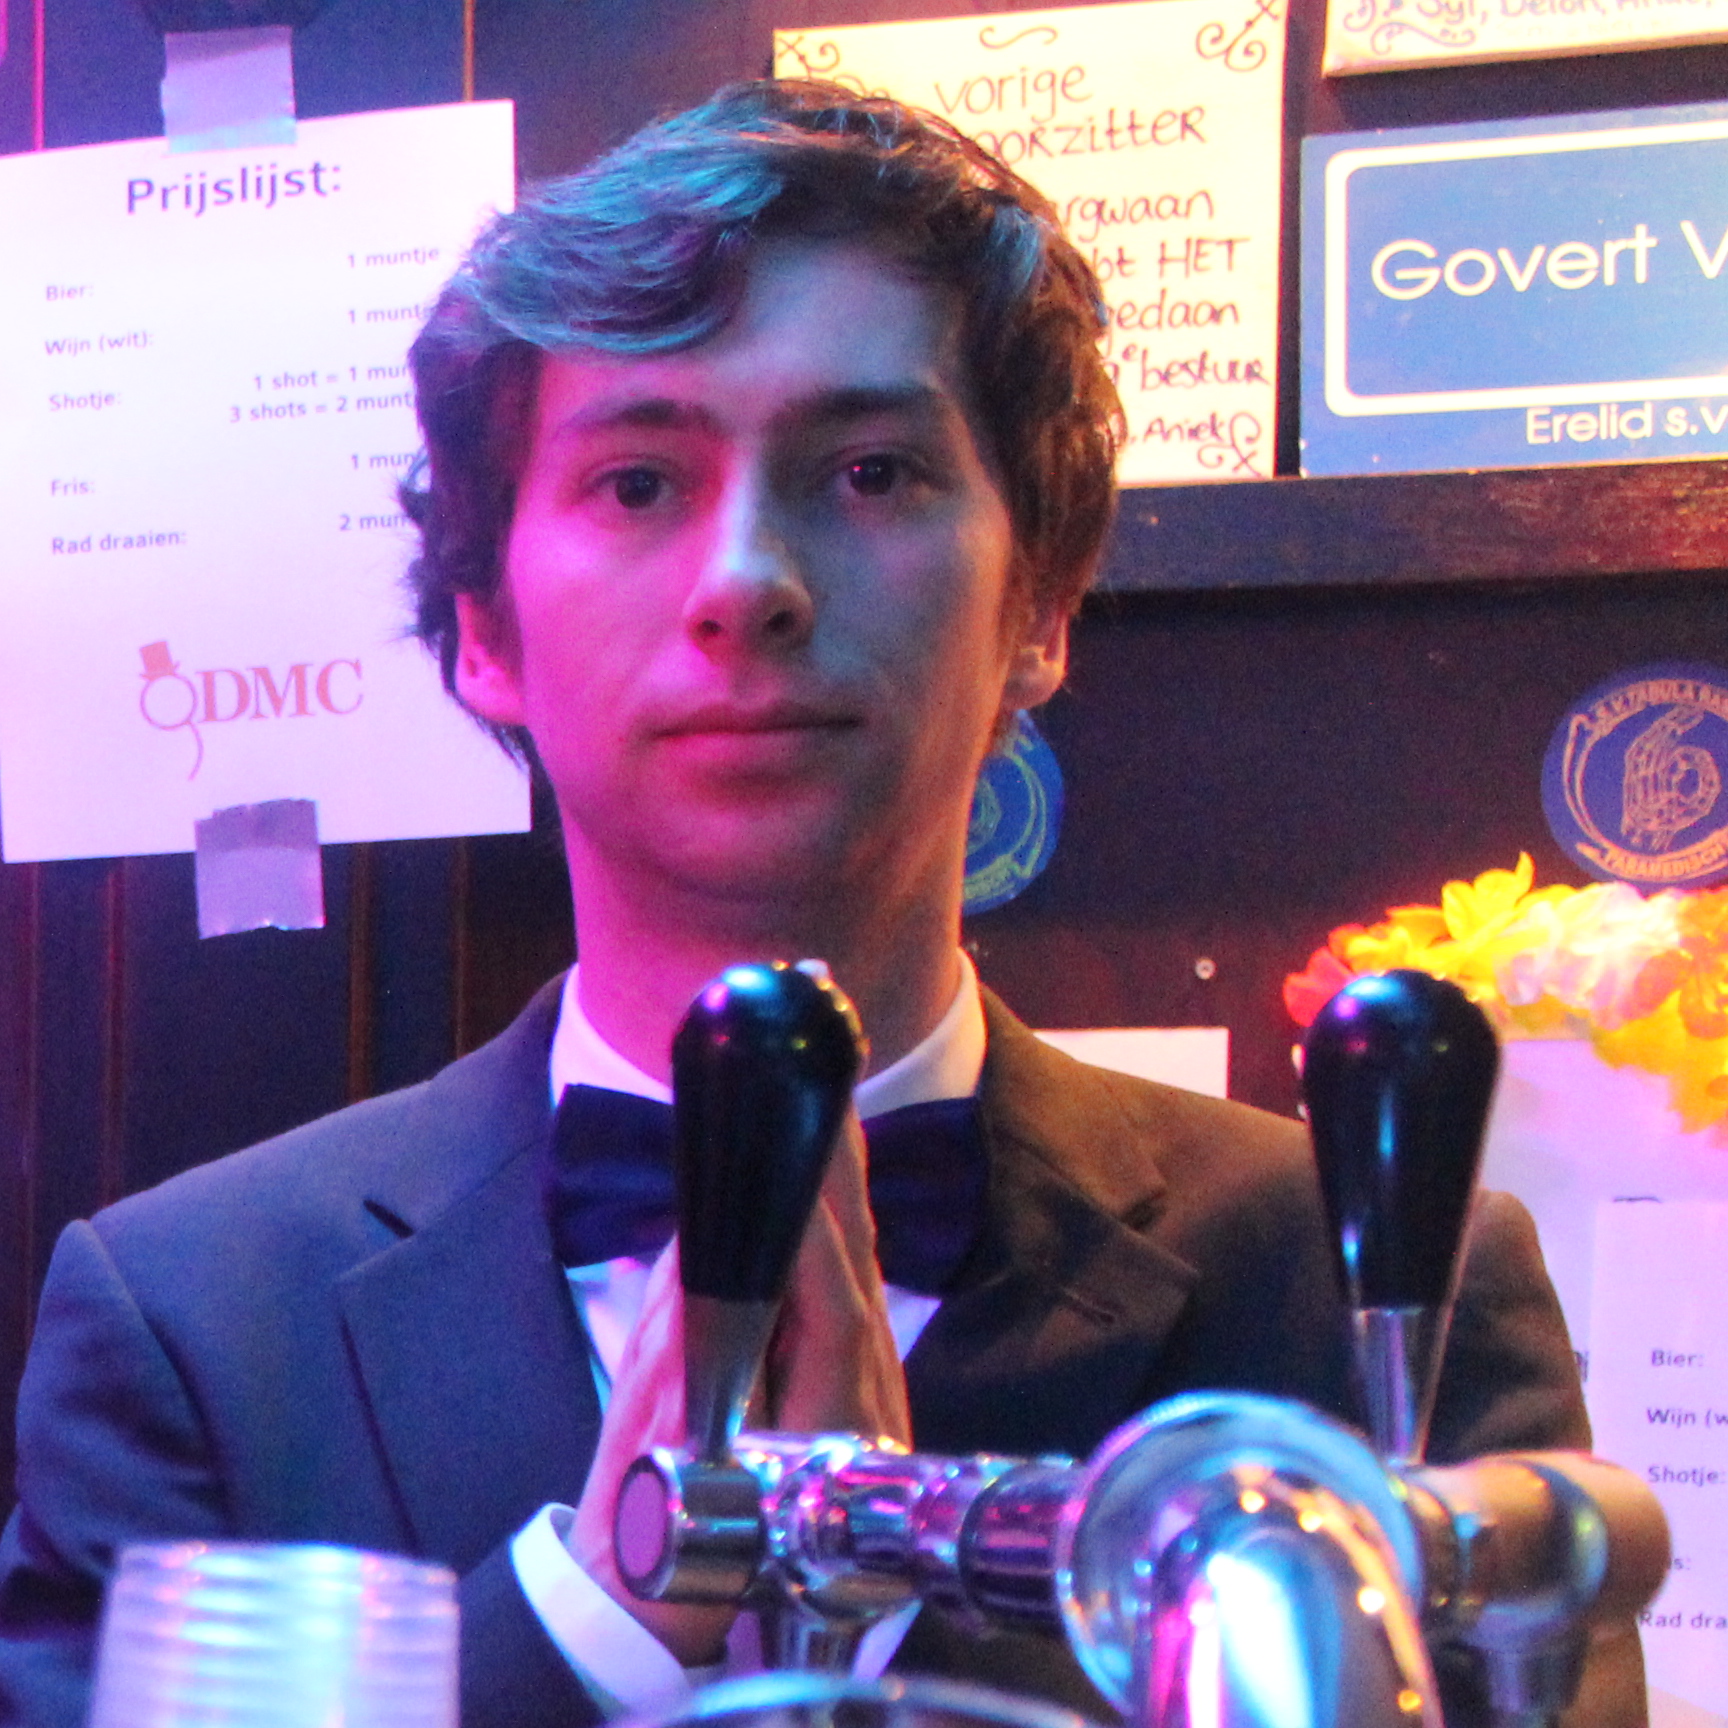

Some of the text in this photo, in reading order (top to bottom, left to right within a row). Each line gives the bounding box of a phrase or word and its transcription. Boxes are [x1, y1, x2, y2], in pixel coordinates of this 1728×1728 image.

[935, 65, 1095, 124] vorige
[126, 161, 342, 218] Prijslijst:
[1064, 189, 1215, 244] rgwaan
[45, 284, 94, 301] Bier:
[366, 246, 440, 267] muntje
[1159, 237, 1251, 279] HET
[1371, 223, 1660, 301] Govert
[44, 338, 92, 357] Wijn
[99, 330, 154, 352] (wit):
[272, 371, 318, 390] shot
[49, 390, 122, 412] Shotje:
[250, 401, 308, 421] shots
[1526, 400, 1654, 445] Erelid
[51, 477, 95, 496] Fris:
[52, 534, 93, 556] Rad
[100, 529, 188, 551] draaien:
[196, 657, 365, 725] DMC
[1651, 1350, 1704, 1367] Bier:
[1647, 1408, 1696, 1428] Wijn
[1647, 1465, 1726, 1487] Shotje:
[1640, 1611, 1682, 1629] Rad
